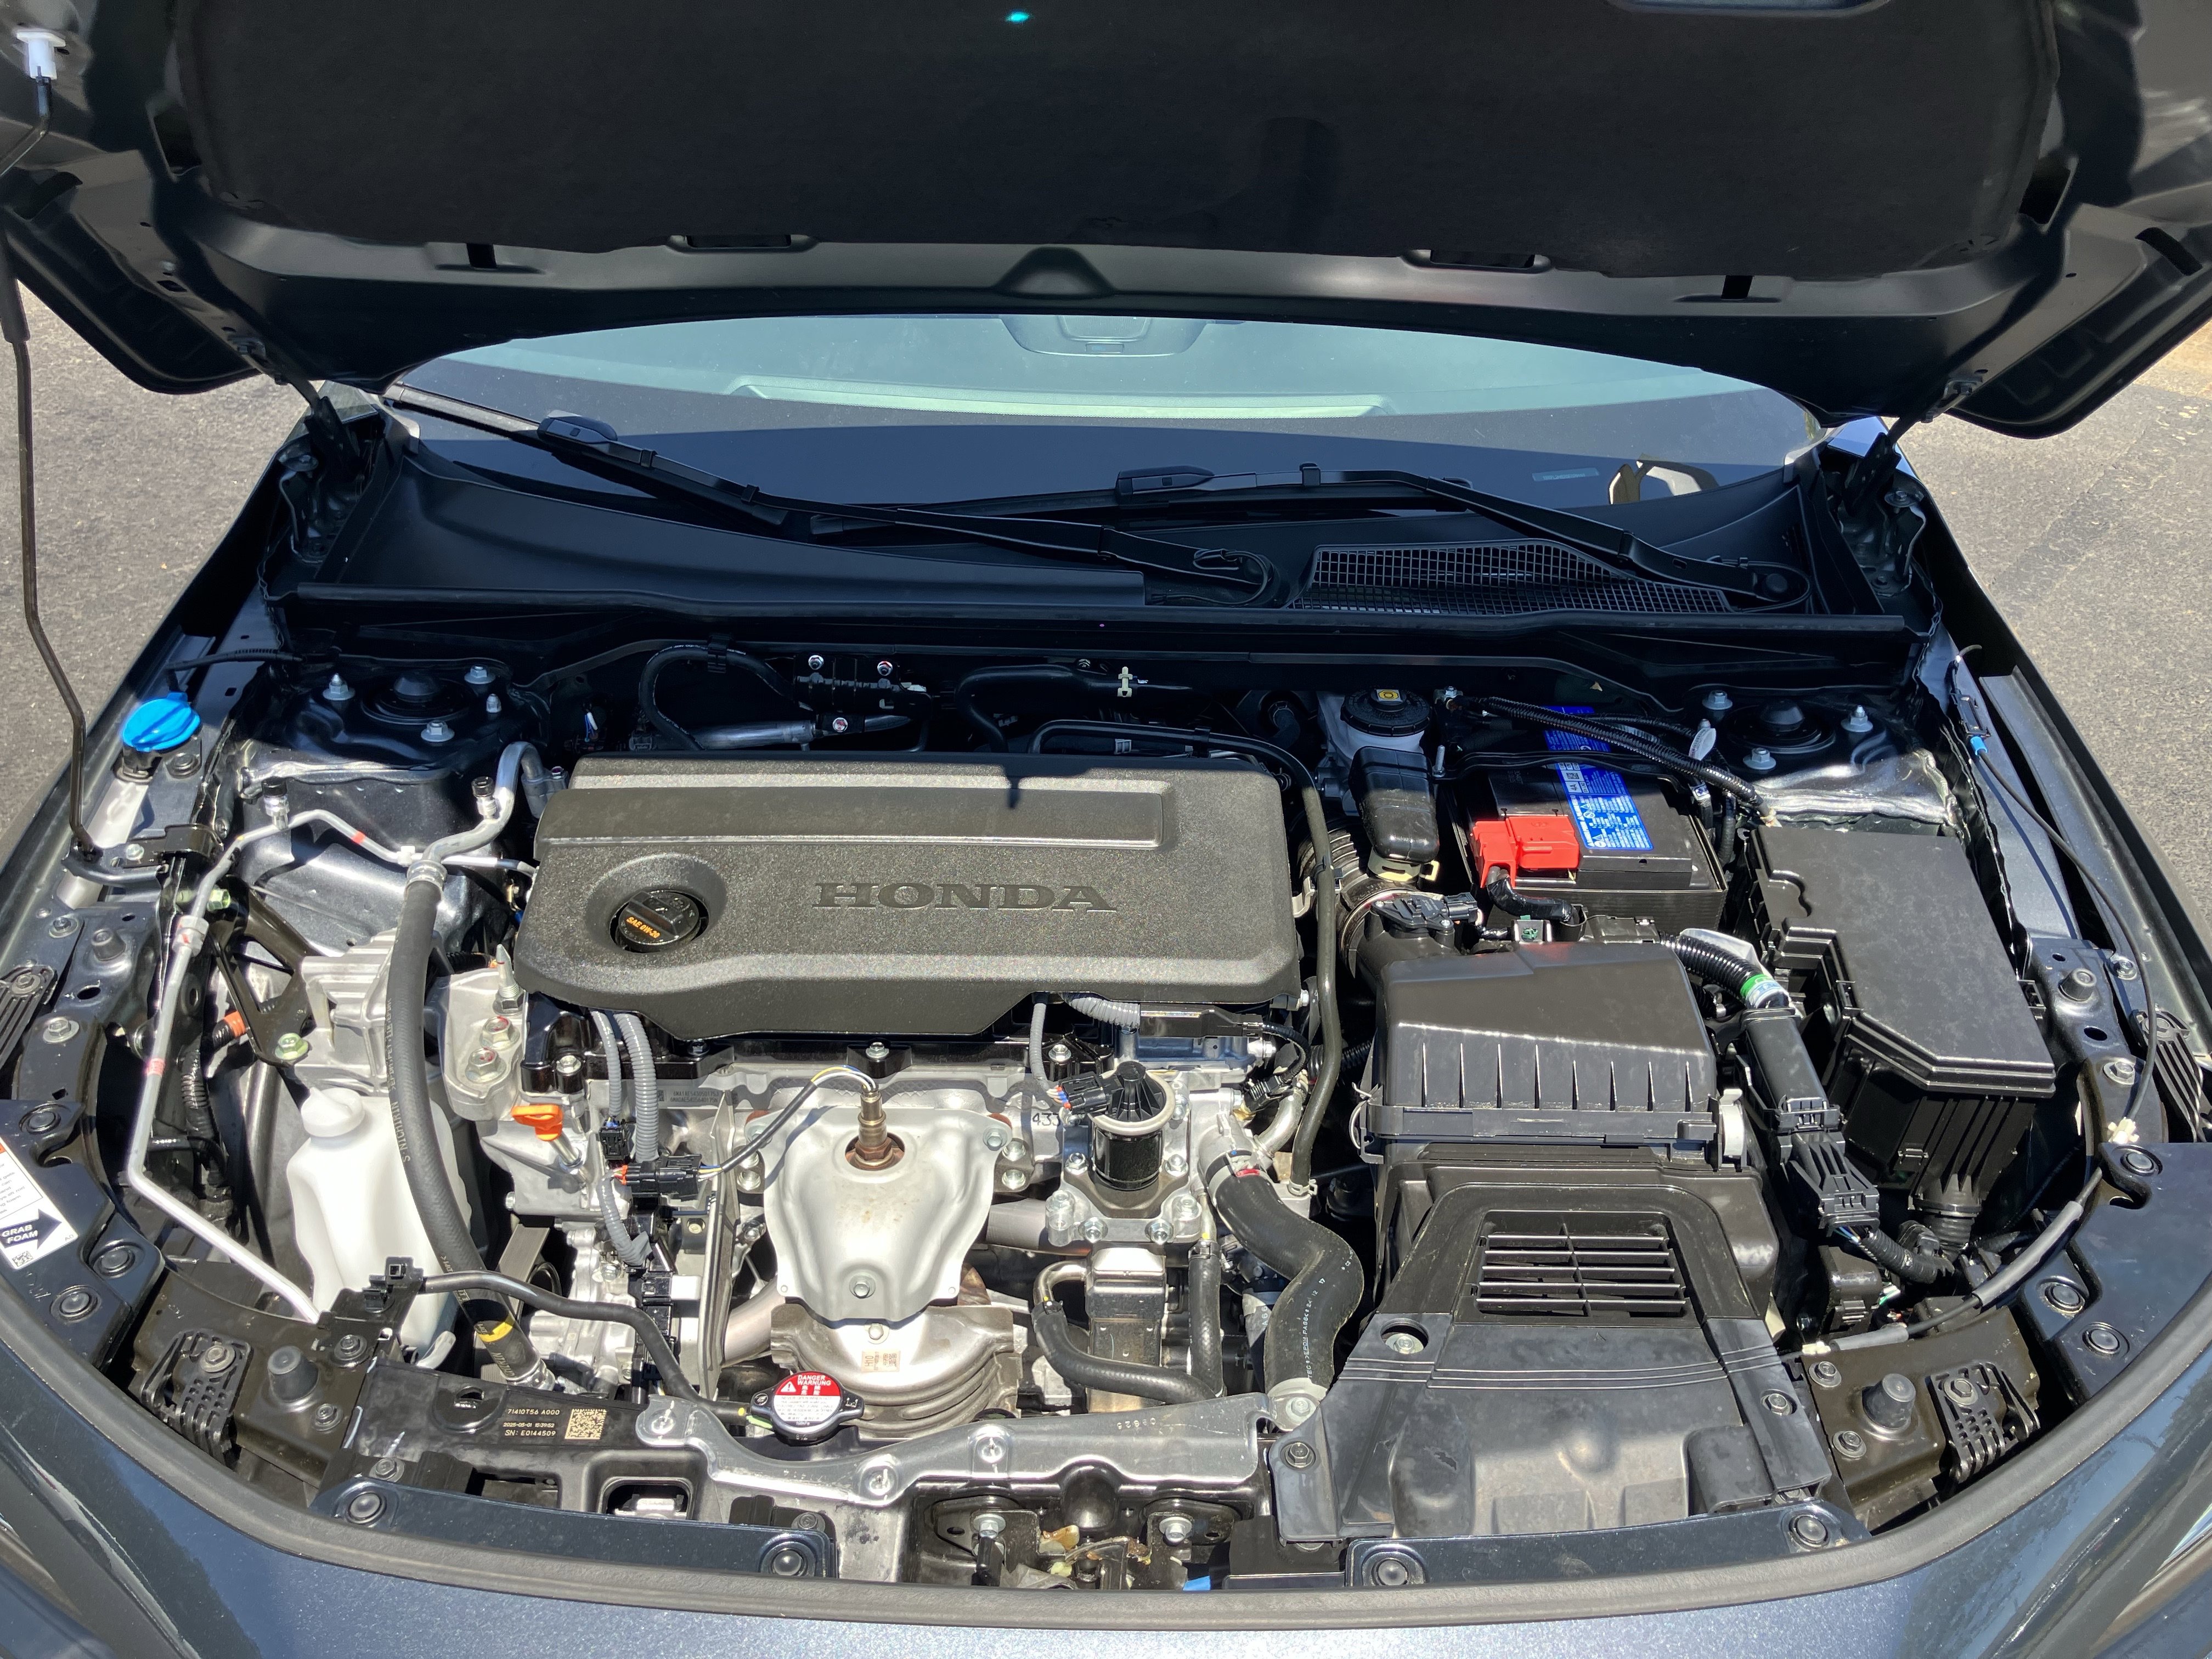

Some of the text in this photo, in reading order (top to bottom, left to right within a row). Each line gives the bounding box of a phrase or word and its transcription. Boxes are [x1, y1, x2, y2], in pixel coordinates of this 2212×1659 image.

[812, 883, 1117, 912] HONDA
[626, 917, 642, 928] SAE
[640, 924, 661, 939] 0W-20
[391, 1101, 408, 1152] NICHIRIN
[2, 1224, 33, 1237] GRAB
[7, 1230, 38, 1244] FOAM
